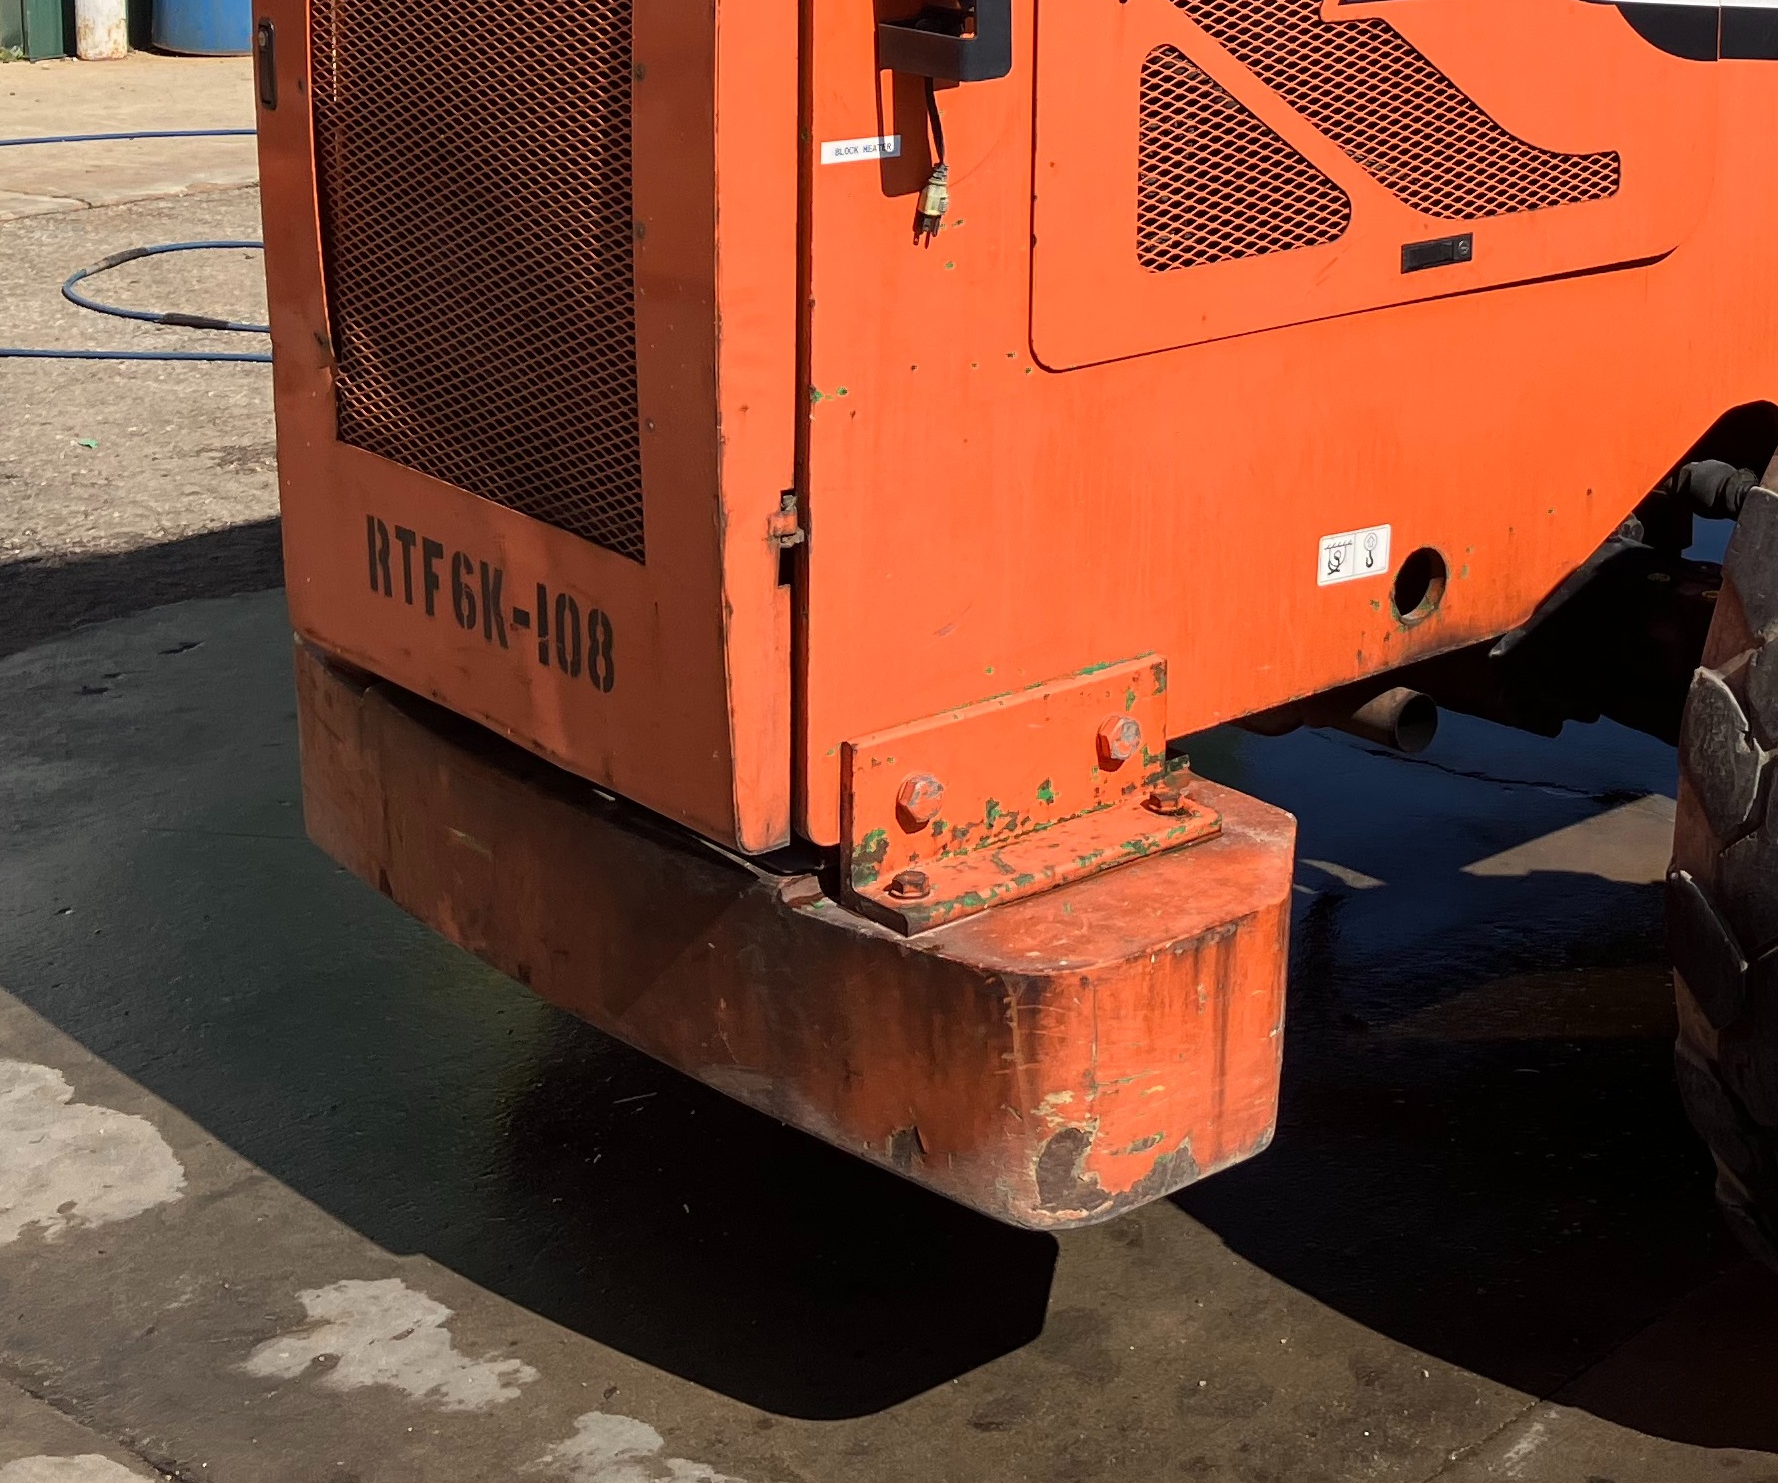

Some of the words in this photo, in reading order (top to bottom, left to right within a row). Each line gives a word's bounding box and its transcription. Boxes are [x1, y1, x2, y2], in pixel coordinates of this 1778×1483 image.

[834, 146, 859, 157] BLOCK
[863, 142, 892, 154] HEATER
[366, 514, 615, 694] RTF6K-108
